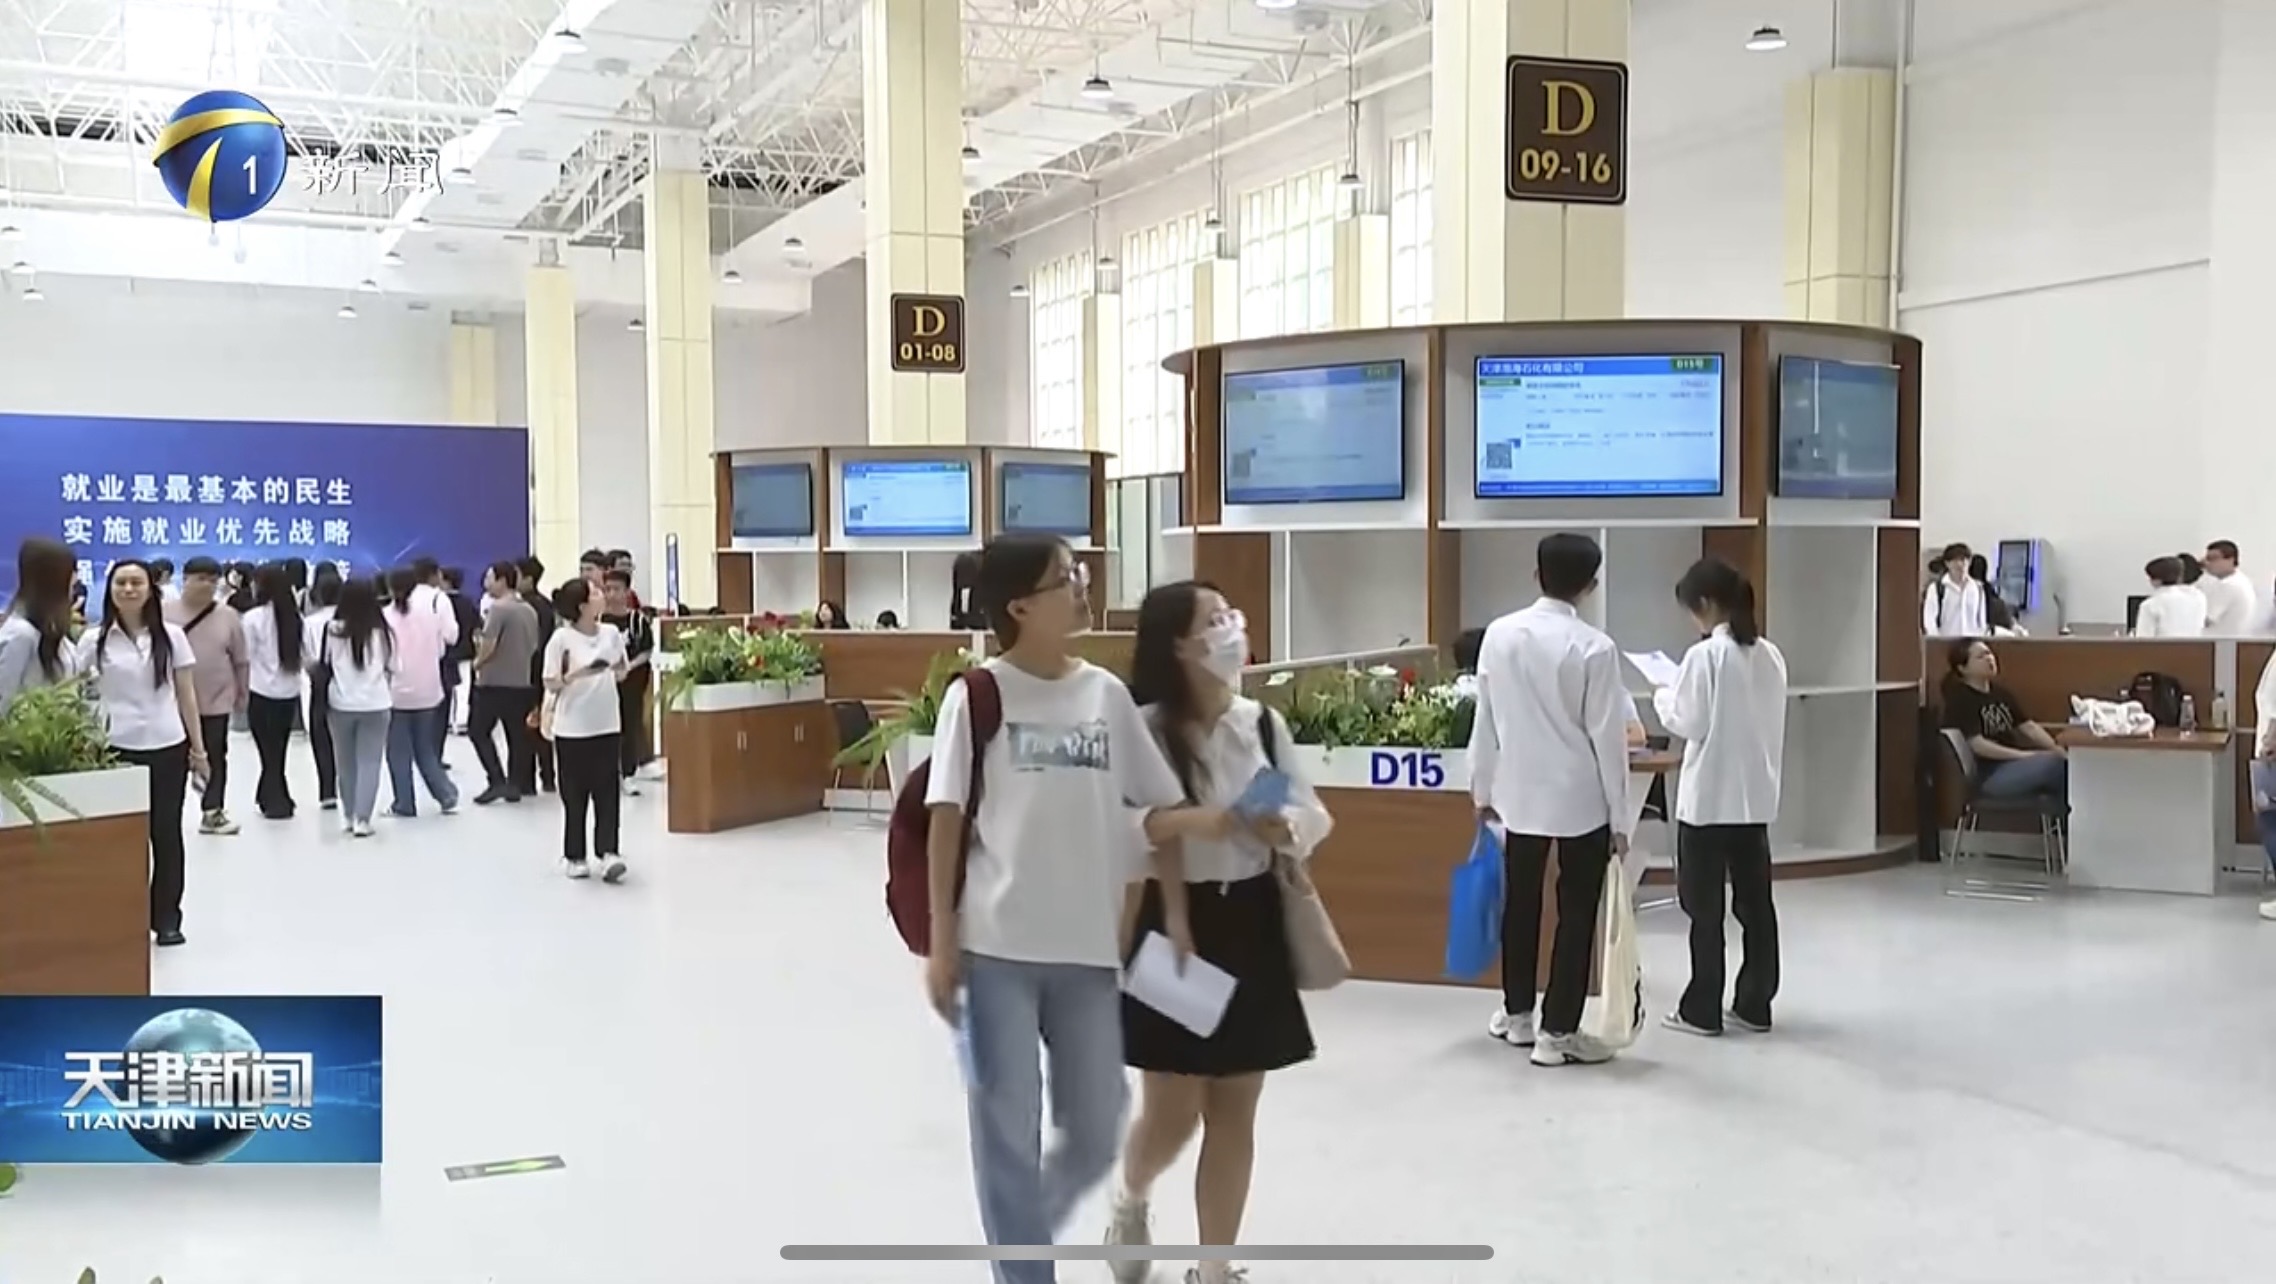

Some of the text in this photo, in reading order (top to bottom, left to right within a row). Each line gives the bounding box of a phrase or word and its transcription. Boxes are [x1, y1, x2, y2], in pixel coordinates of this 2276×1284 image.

[1541, 80, 1595, 134] D
[1520, 148, 1612, 183] 09-16
[912, 306, 946, 336] D
[900, 343, 956, 361] 01-08
[61, 473, 353, 506] 就业是最基本的民生
[62, 515, 352, 546] 实施就业优先战略
[1371, 751, 1445, 788] D15
